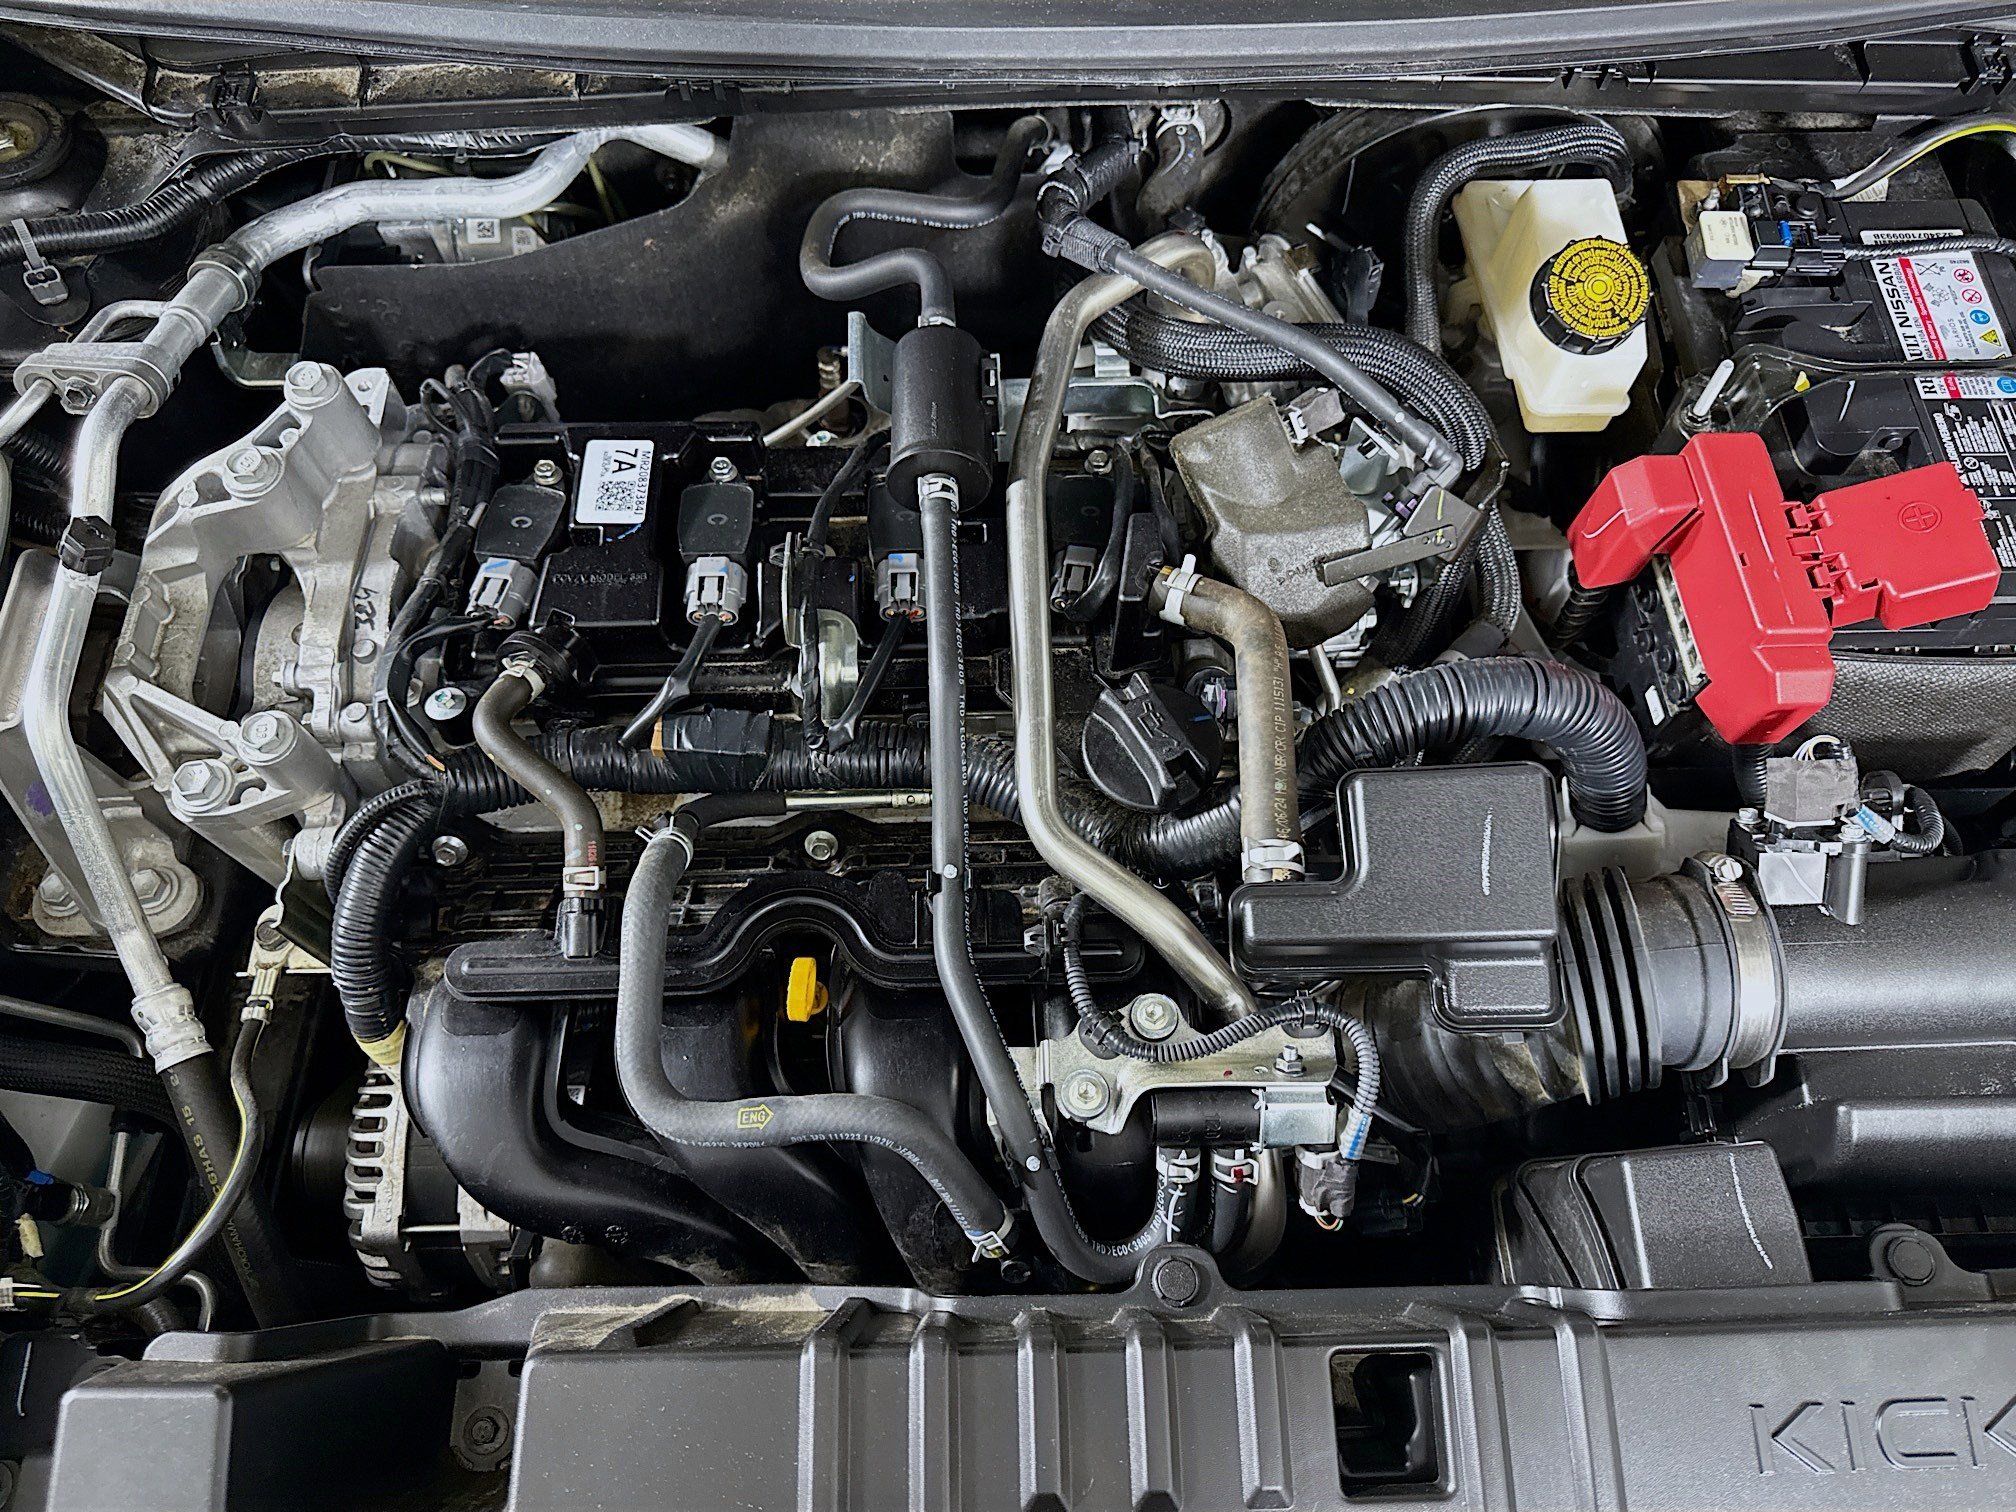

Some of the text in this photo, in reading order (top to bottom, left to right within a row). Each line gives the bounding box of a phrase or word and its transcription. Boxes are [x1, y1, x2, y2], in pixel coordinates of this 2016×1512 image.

[1876, 262, 1913, 328] NISSAN
[1948, 319, 1964, 348] CLARIOS
[612, 448, 639, 474] 7A
[958, 694, 968, 786] TRD>ECO<3805
[962, 794, 971, 870] TRD>ECO<380
[742, 1110, 766, 1123] ENG
[828, 1133, 862, 1142] 111223
[1091, 1231, 1152, 1257] TRD>ECO<3805
